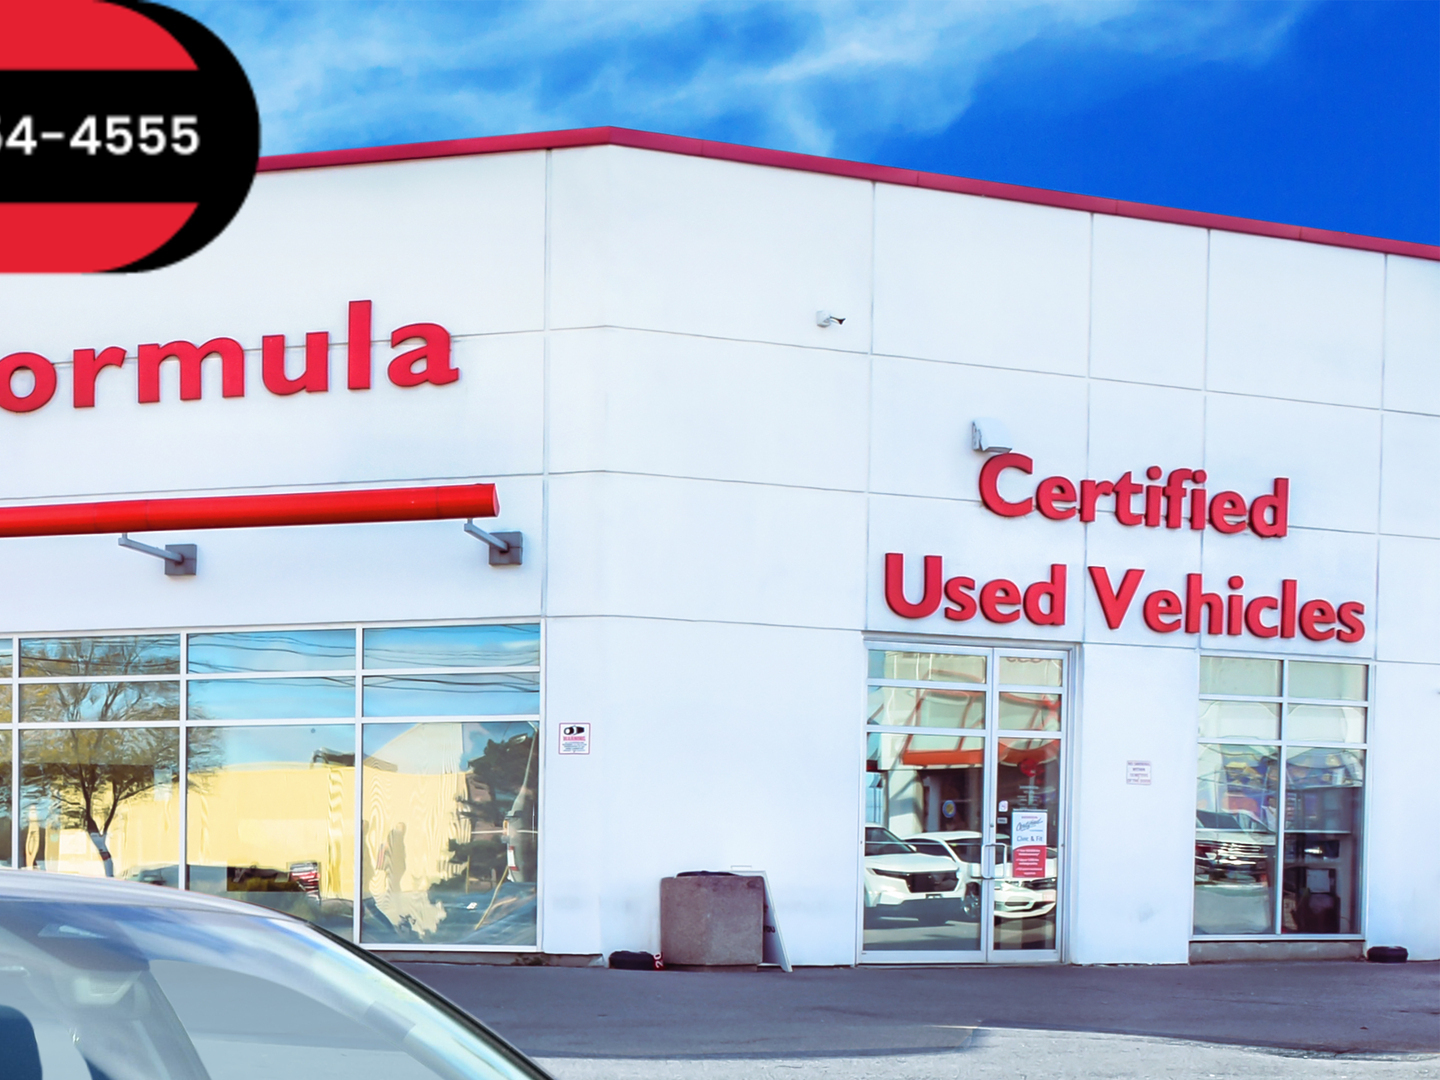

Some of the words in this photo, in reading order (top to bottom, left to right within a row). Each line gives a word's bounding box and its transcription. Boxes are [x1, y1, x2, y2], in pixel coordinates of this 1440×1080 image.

[978, 452, 1290, 538] Certified
[884, 552, 1068, 626] Used
[1088, 566, 1366, 643] Vehicles
